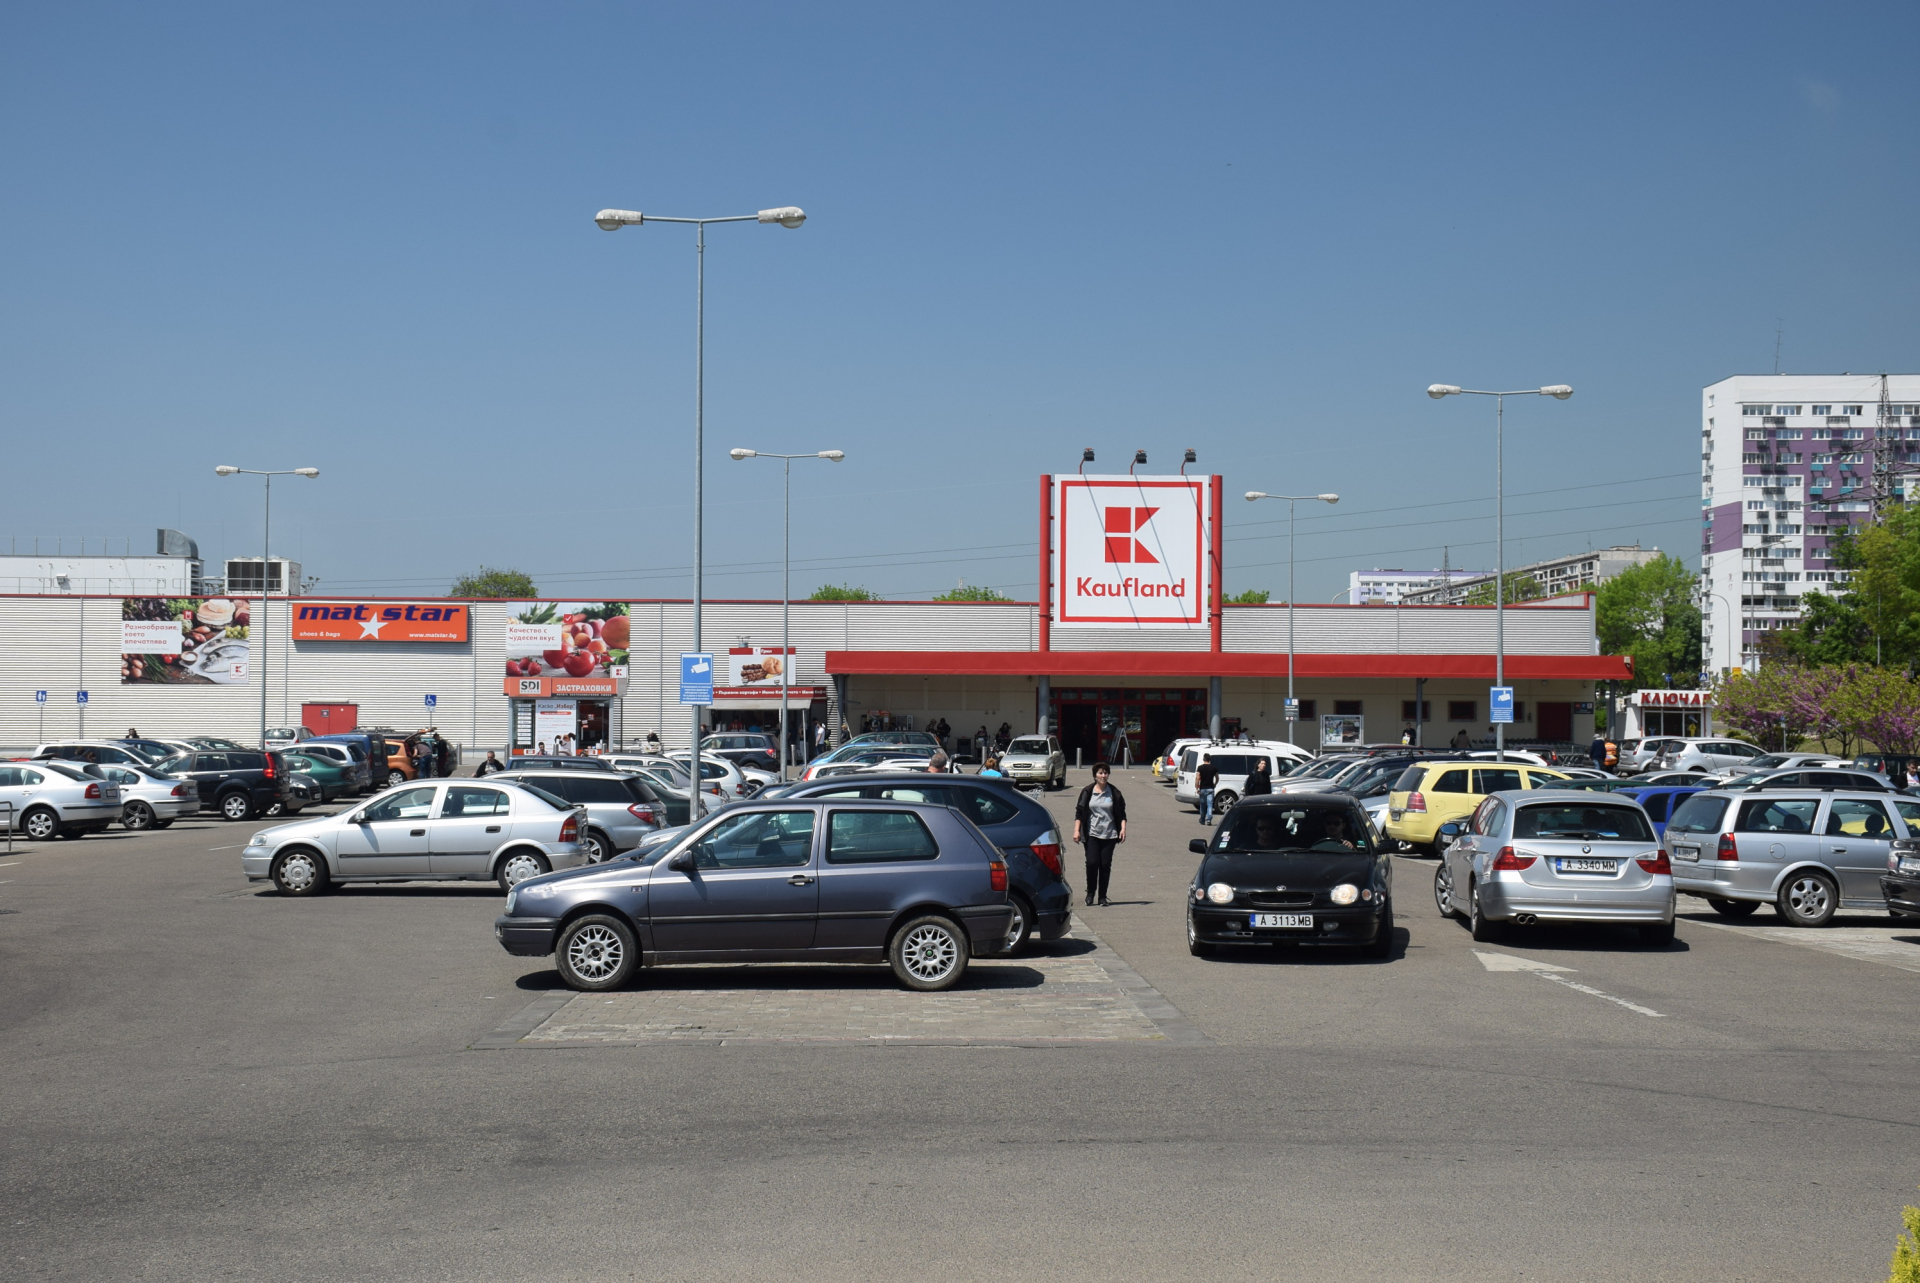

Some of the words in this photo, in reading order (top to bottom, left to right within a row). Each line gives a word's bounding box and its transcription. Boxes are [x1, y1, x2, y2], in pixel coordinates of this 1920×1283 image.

[1077, 577, 1185, 597] Kaufland
[298, 604, 369, 621] mat
[381, 605, 460, 622] star
[124, 623, 179, 631] Разнообразие,
[521, 681, 540, 690] SDI
[556, 684, 612, 692] ЗАСТРАХОВКИ
[1567, 860, 1572, 869] A
[1577, 860, 1600, 870] 3340
[1602, 860, 1615, 871] MM
[1260, 915, 1266, 926] A
